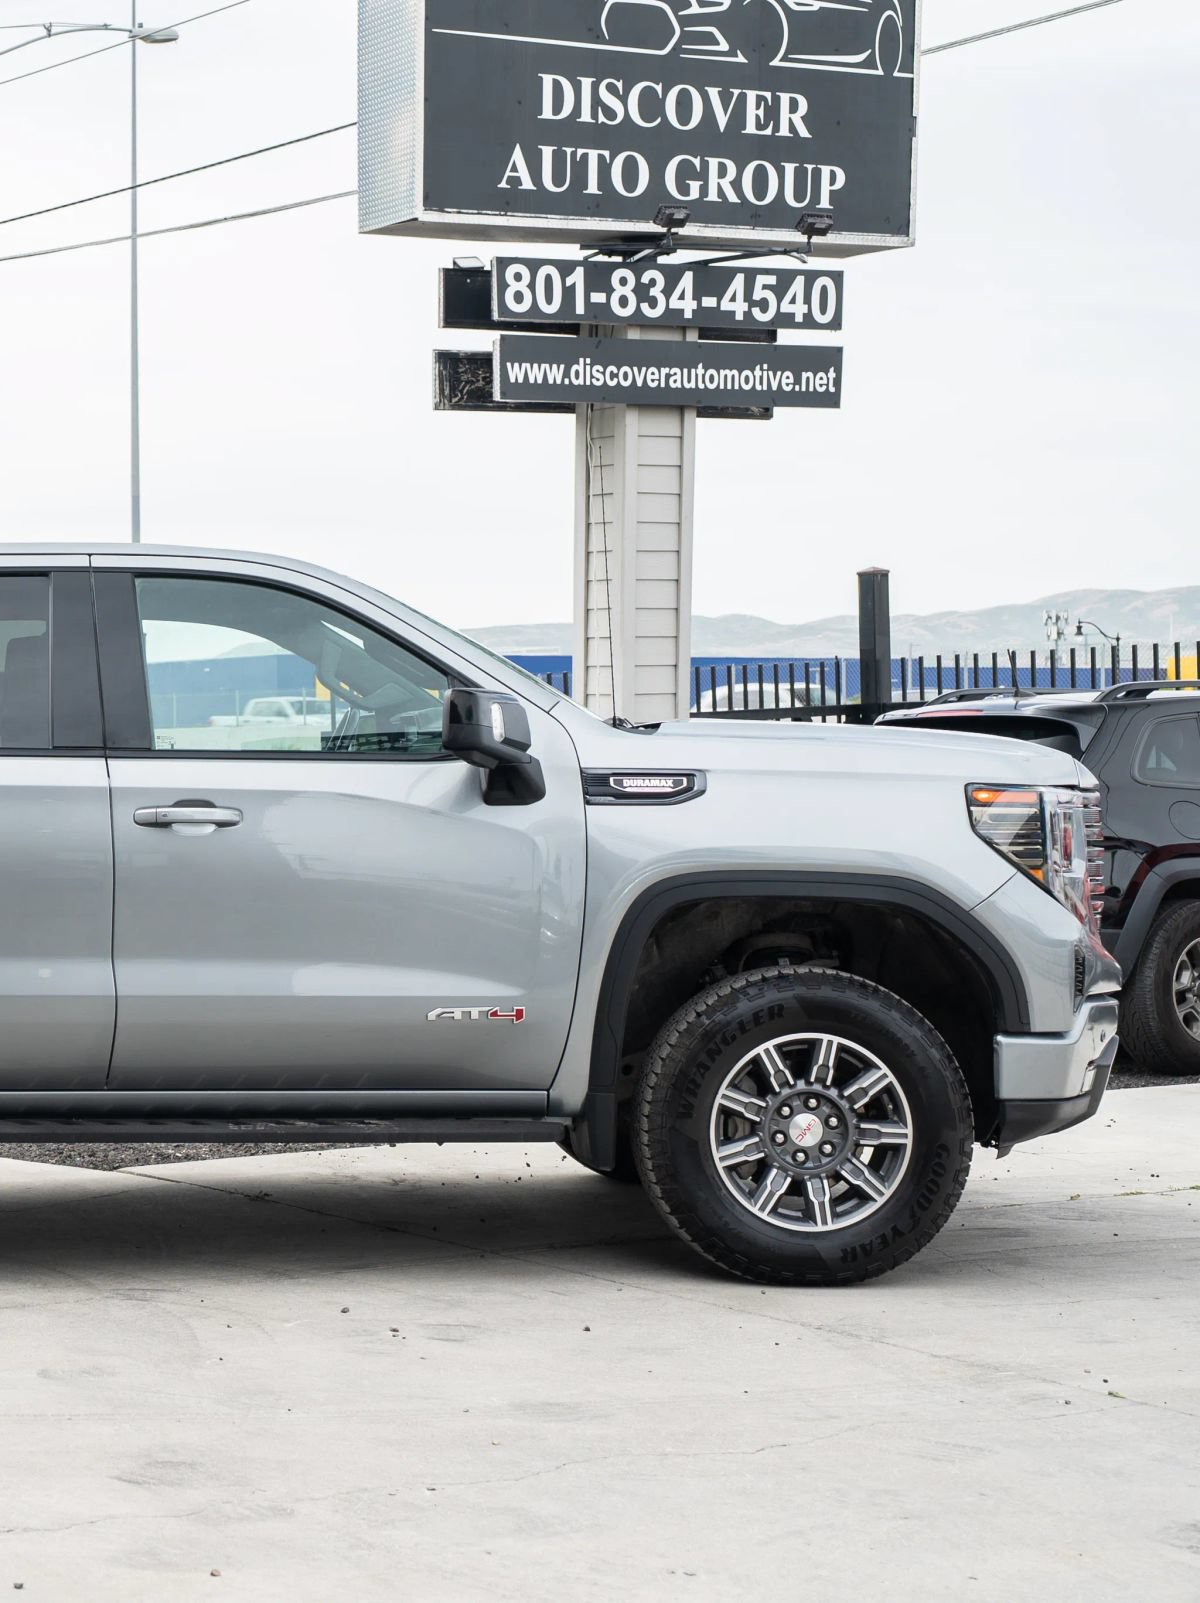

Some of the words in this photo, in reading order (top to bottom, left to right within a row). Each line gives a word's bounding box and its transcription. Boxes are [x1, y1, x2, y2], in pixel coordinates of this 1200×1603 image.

[537, 73, 812, 138] DISCOVER
[497, 143, 650, 197] AUTO
[664, 154, 846, 209] GROUP
[504, 264, 837, 324] 801-834-4540
[506, 357, 836, 393] www.discoverautomotive.net
[622, 778, 674, 788] DURAMAX
[426, 1006, 525, 1024] AT4
[677, 1003, 784, 1118] WRANGLER
[795, 1118, 817, 1143] GMC
[841, 1144, 951, 1263] GOODYEAR
